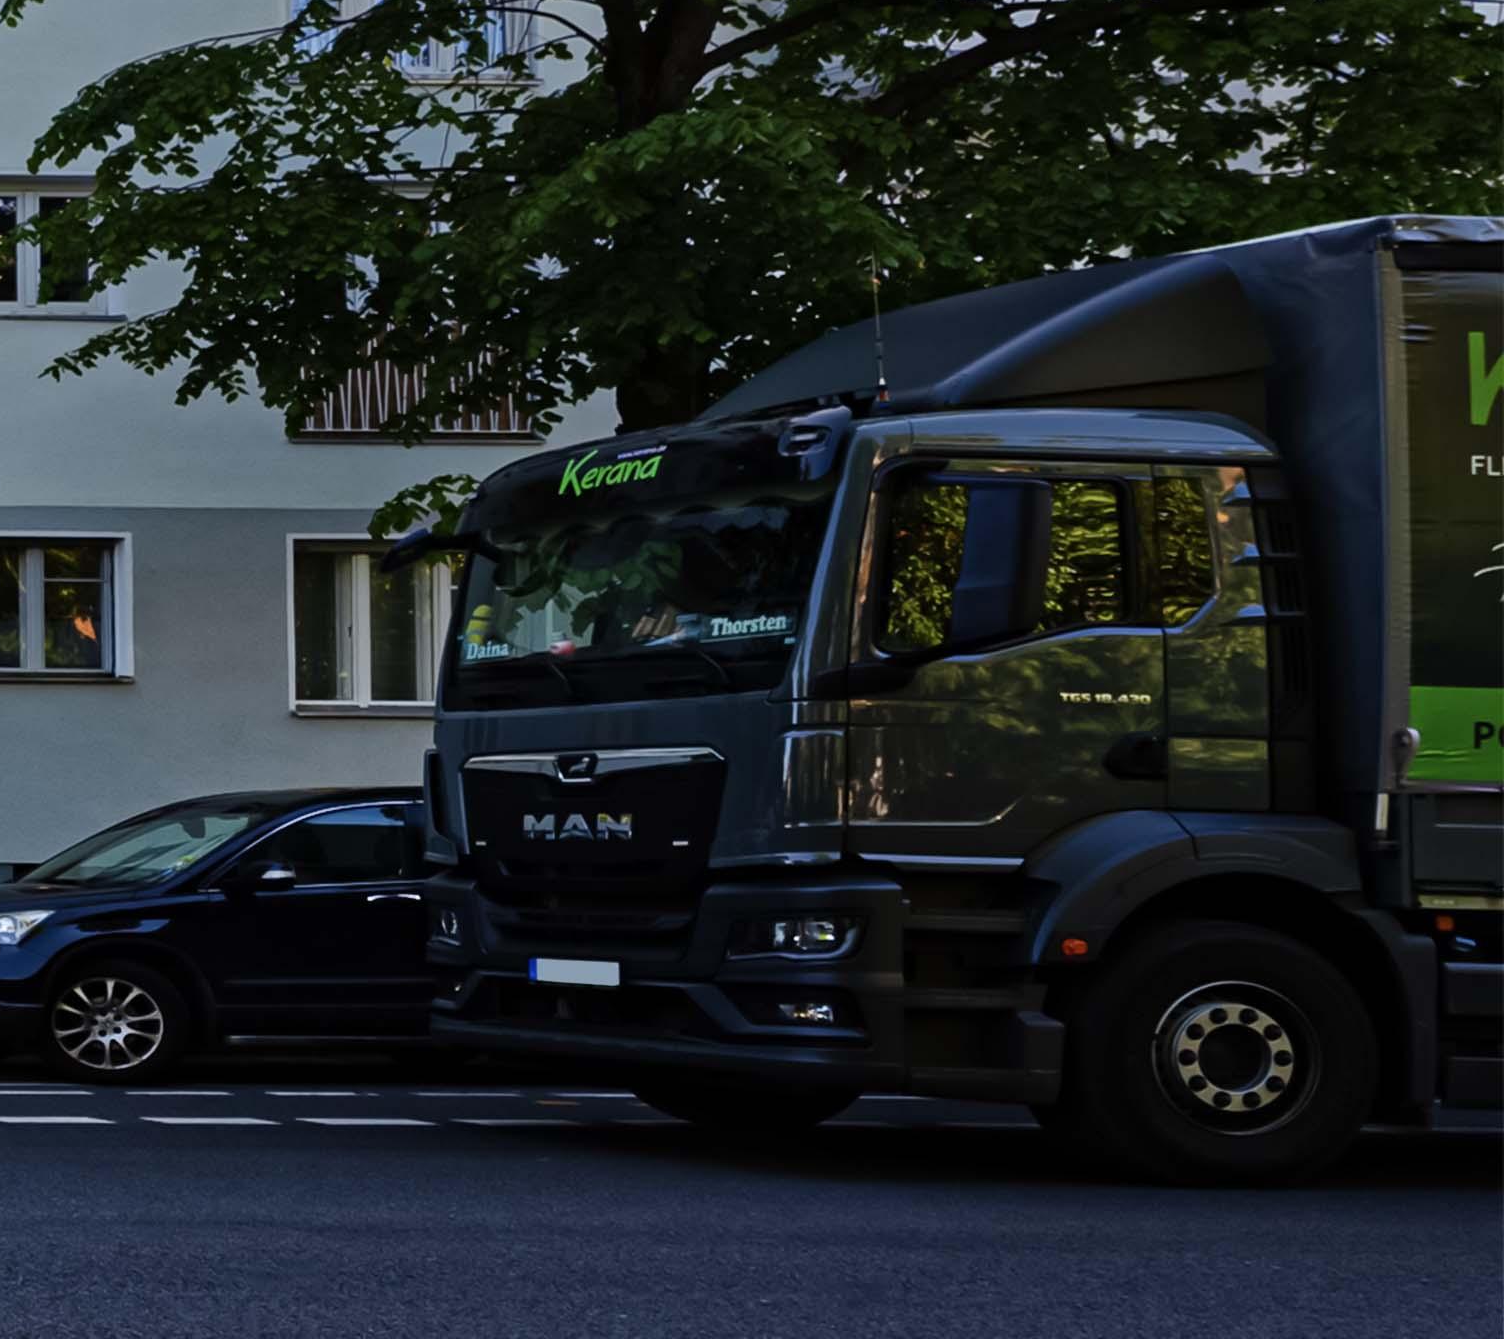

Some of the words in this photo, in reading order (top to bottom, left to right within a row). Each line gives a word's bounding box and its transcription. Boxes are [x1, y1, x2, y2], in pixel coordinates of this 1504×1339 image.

[558, 449, 663, 496] Kerana
[710, 614, 787, 636] Thorsten
[466, 640, 509, 660] Daina
[1059, 691, 1091, 703] TGS
[523, 813, 632, 840] MAN
